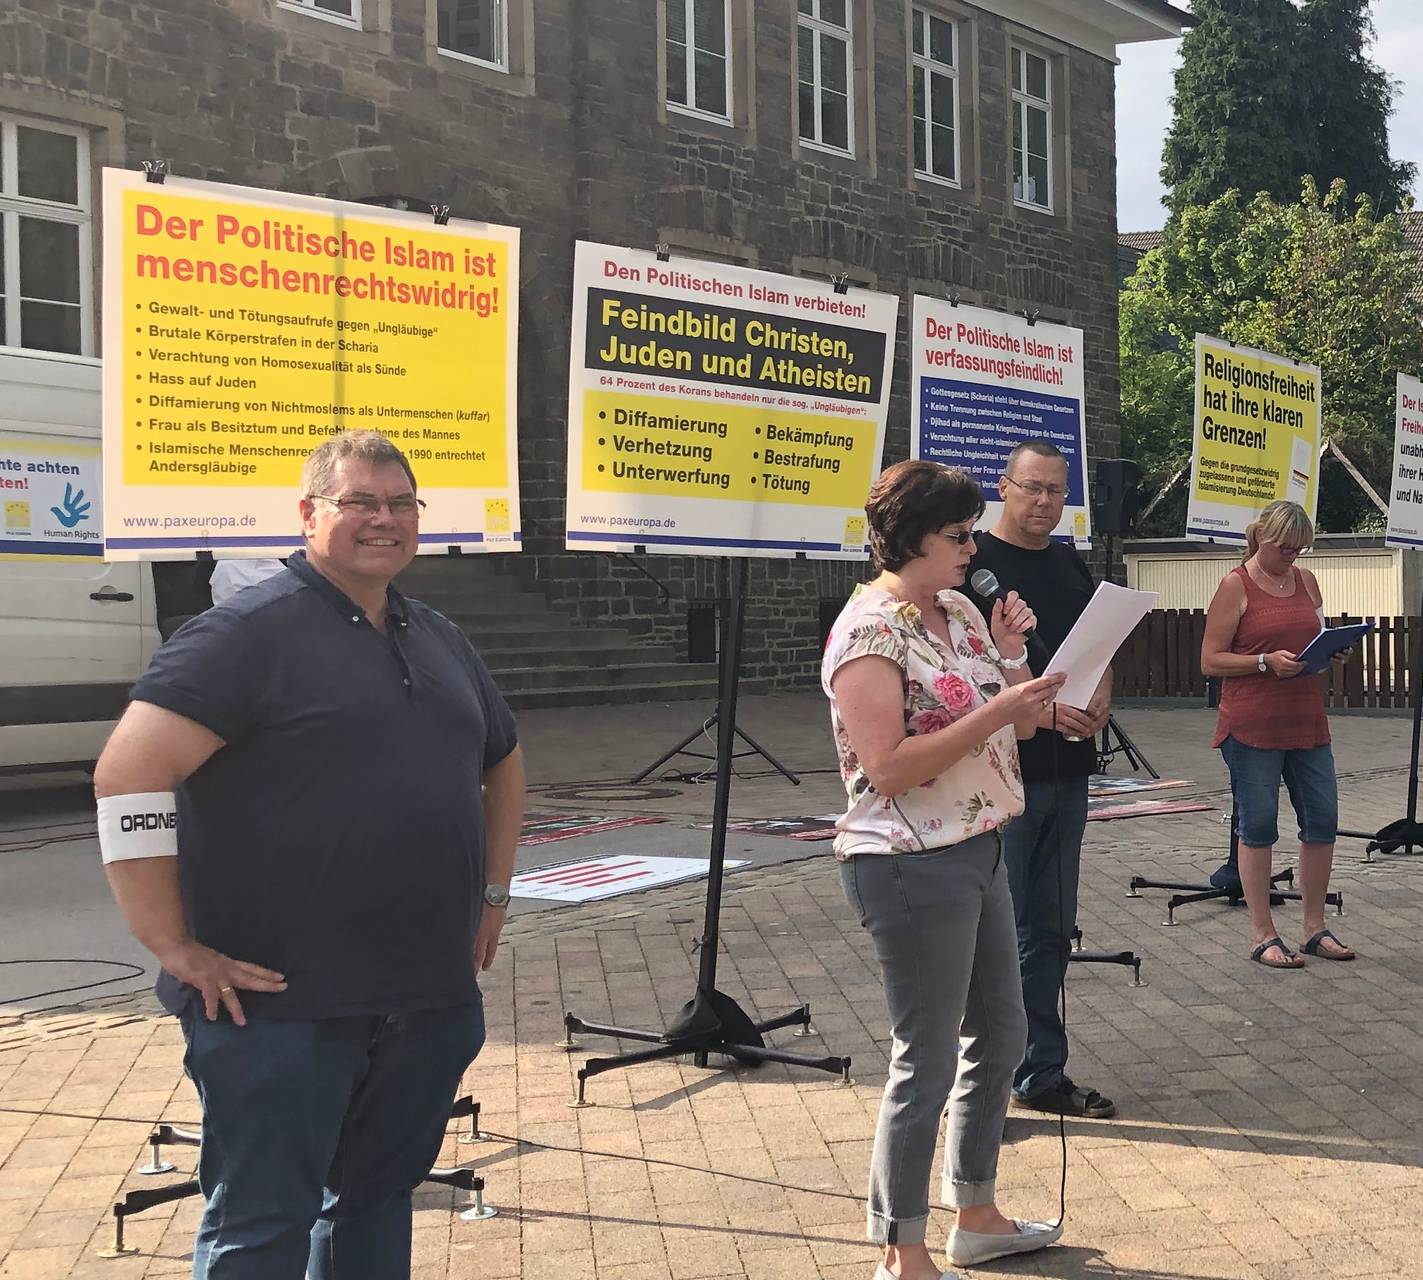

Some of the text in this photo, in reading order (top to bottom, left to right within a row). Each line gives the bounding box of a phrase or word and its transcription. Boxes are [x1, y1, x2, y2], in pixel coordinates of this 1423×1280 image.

[136, 205, 496, 277] Der Politische Islam ist
[136, 253, 499, 317] menschenrechtswidrig!
[604, 261, 865, 319] Den Politischen Islam verbieten!
[148, 301, 438, 339] Gewalt- und Tötungsaufrufe gegen „Ungläubige“
[601, 298, 854, 362] Feindbild Christen,
[148, 325, 379, 353] Brutale Körperstrafen in der Scharia
[926, 318, 1073, 363] Der Politische Islam ist
[148, 348, 406, 376] Verachtung von Homosexualität als Sünde
[600, 335, 872, 395] Juden und Atheisten
[926, 348, 1063, 385] verfassungsfeindlich!
[148, 372, 256, 389] Hass auf Juden
[1205, 353, 1316, 403] Religionsfreiheit
[600, 376, 613, 387] 64
[616, 377, 655, 392] Prozent
[659, 383, 676, 393] des
[679, 384, 711, 397] Korans
[714, 389, 759, 402] behandeln
[762, 395, 775, 405] nur
[778, 396, 790, 407] die
[792, 399, 808, 409] sog.
[931, 388, 969, 400] Gottesgesetz
[1402, 395, 1415, 409] Der
[148, 395, 490, 423] Diffamierung von Nichtmoslems als Untermenschen (kuffar)
[930, 403, 948, 412] Keine
[950, 405, 976, 416] Trennung
[1204, 384, 1303, 428] hat ihre klaren
[148, 419, 181, 432] Frau
[186, 420, 207, 433] als
[211, 420, 277, 435] Besitztum
[282, 423, 305, 436] und
[403, 427, 419, 439] des
[422, 428, 460, 440] Mannes
[614, 409, 727, 437] Diffamierung
[952, 420, 960, 428] als
[1202, 416, 1267, 450] Grenzen!
[613, 435, 712, 461] Verhetzung
[766, 425, 853, 450] Bekämpfung
[930, 433, 964, 444] Verachtung
[148, 443, 225, 455] Islamische
[409, 448, 432, 460] 1990
[435, 449, 486, 462] entrechtet
[765, 450, 841, 473] Bestrafung
[930, 448, 962, 457] Rechtliche
[28, 462, 79, 475] achten
[149, 461, 257, 475] Andersgläubige
[983, 466, 996, 474] Frau
[1200, 457, 1218, 471] Gegen
[1221, 460, 1229, 471] die
[1399, 465, 1417, 480] ihrer
[612, 462, 730, 489] Unterwerfung
[762, 473, 810, 494] Tötung
[1199, 472, 1275, 489] zugelassene und geförderte
[1199, 482, 1236, 496] Islamisierung
[1396, 490, 1411, 502] und
[123, 515, 256, 529] www.paxeuropa.de
[581, 514, 676, 529] www.paxeuropa.de
[44, 530, 100, 540] Human Rights
[121, 812, 176, 832] ORDNE
